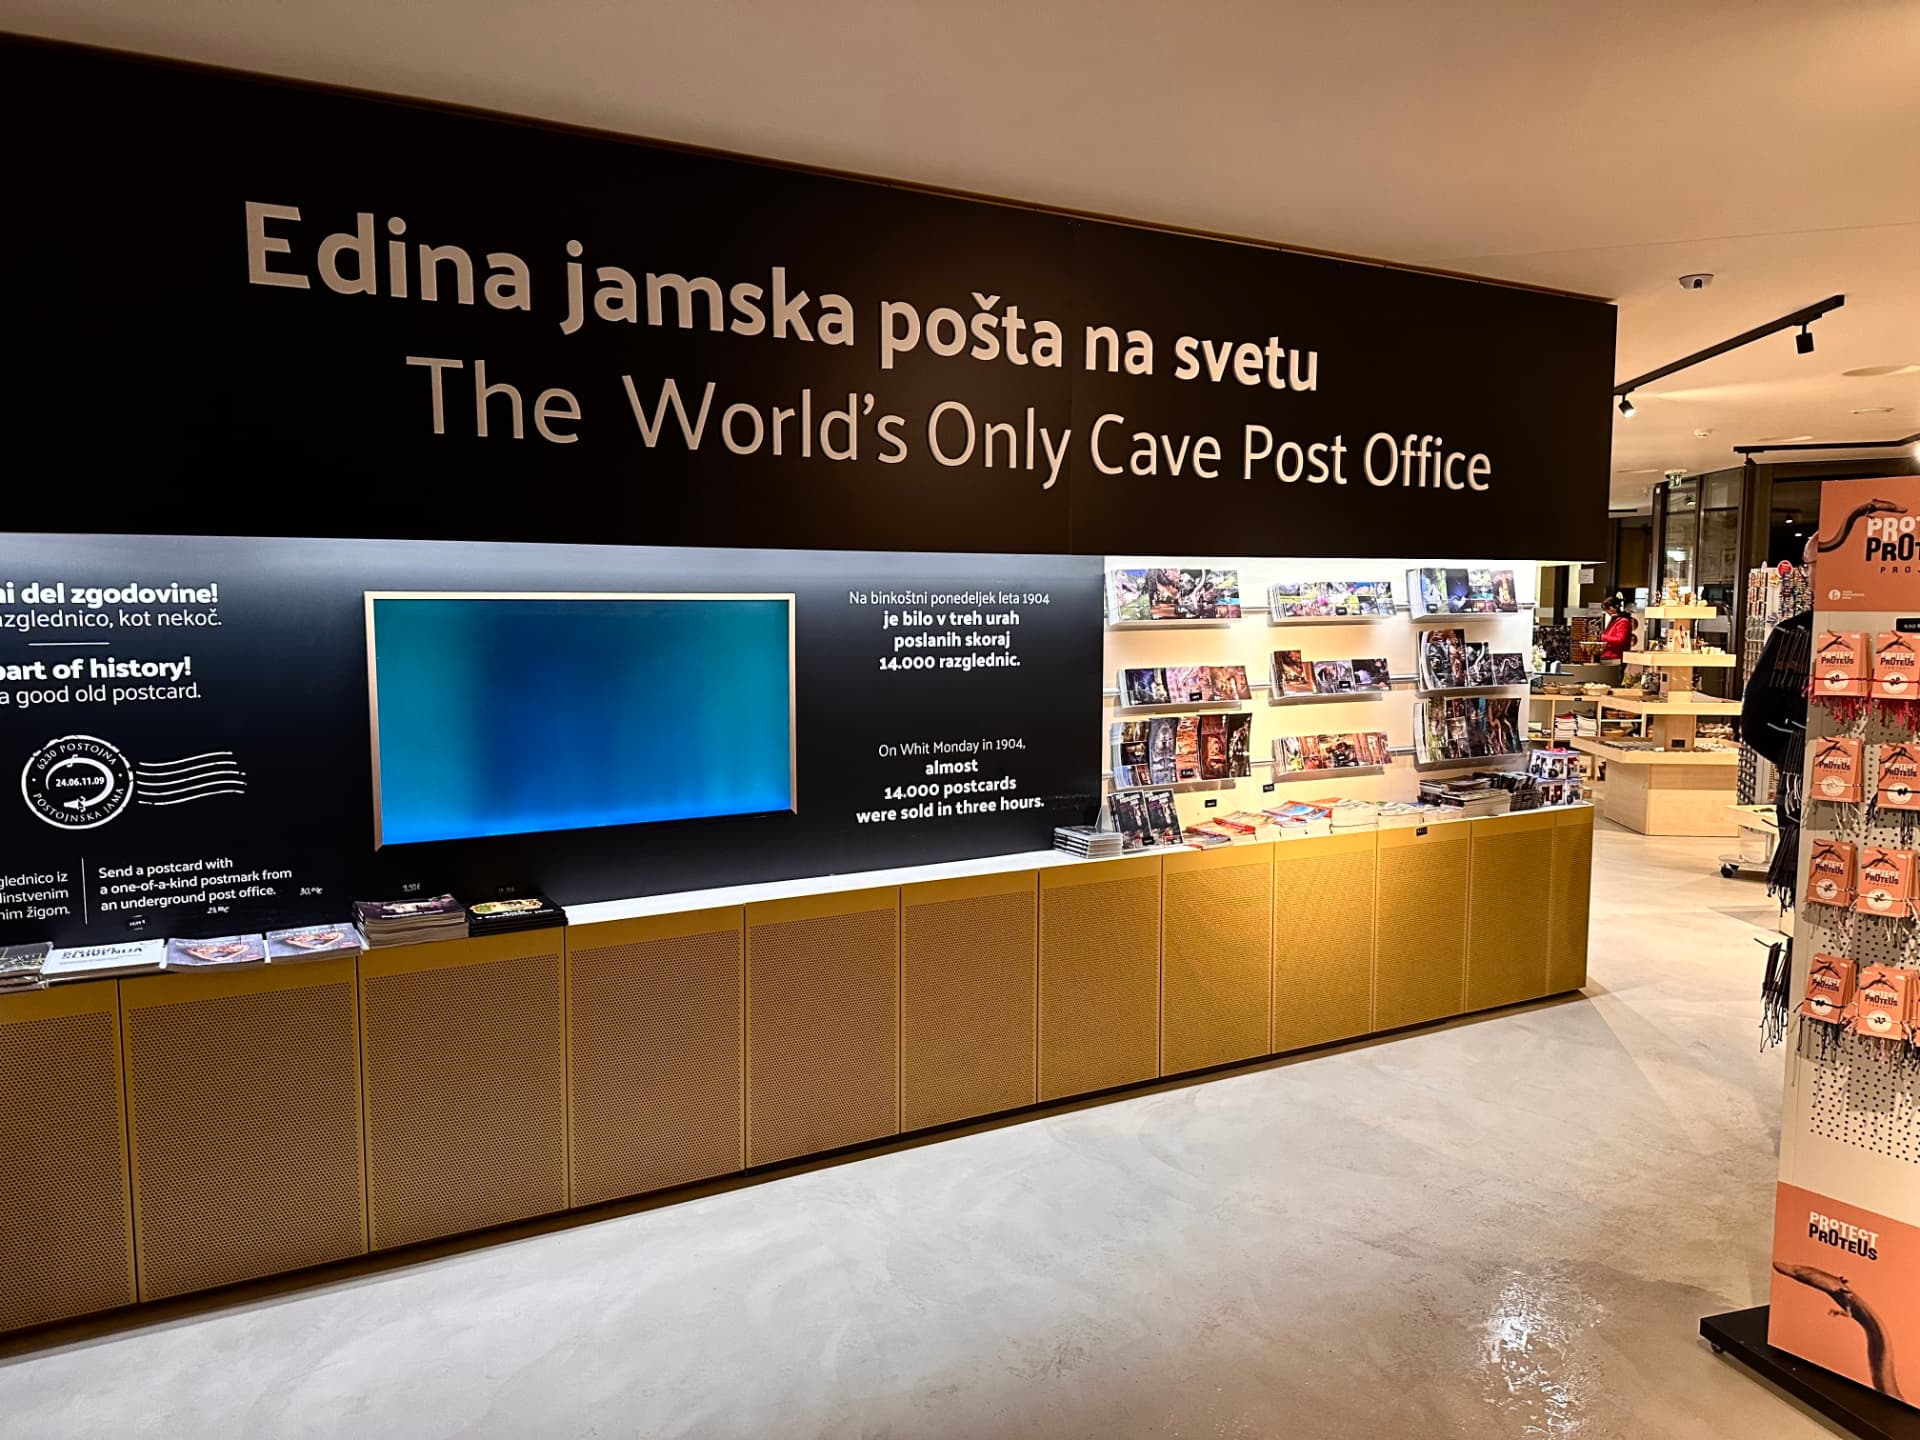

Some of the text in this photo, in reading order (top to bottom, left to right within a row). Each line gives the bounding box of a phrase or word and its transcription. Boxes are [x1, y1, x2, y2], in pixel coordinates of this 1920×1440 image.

[246, 201, 1317, 391] Edina jamska pošta na svetu
[407, 356, 581, 443] The
[929, 402, 1071, 489] Only
[1091, 414, 1221, 478] Cave
[1244, 425, 1347, 484] Post
[1365, 433, 1491, 490] Office
[1866, 516, 1920, 542] PRO
[1880, 566, 1920, 574] PRO
[21, 583, 64, 603] del
[71, 583, 218, 608] zgodovine!
[850, 590, 1050, 607] Na binkoštni ponedeljek leta 1904
[0, 608, 221, 632] zglednico, kot nekoč.
[883, 610, 1019, 629] je bilo v treh urah
[895, 631, 1010, 651] poslanih skoraj
[53, 659, 84, 679] of
[90, 656, 191, 681] history!
[880, 652, 1020, 671] 14.000 razglednic.
[0, 682, 201, 708] a good old postcard.
[879, 745, 896, 757] On
[900, 743, 929, 755] Whit
[934, 740, 979, 754] Monday
[983, 739, 992, 750] in
[37, 749, 57, 770] 6230
[926, 759, 978, 775] almost
[55, 776, 105, 787] 24.06.11.09
[885, 776, 1016, 799] 14.000 postcards
[856, 797, 1044, 823] were sold in three hours.
[57, 872, 68, 882] iz
[99, 865, 132, 878] Send
[147, 860, 202, 877] postcard
[205, 858, 233, 869] with
[111, 876, 197, 893] one-of-a-kind
[201, 871, 259, 888] postmark
[262, 870, 292, 880] from
[0, 889, 68, 903] instvenim
[101, 886, 275, 911] an underground post office.
[27, 907, 70, 919] žigom.
[1809, 1211, 1879, 1249] PROTECT
